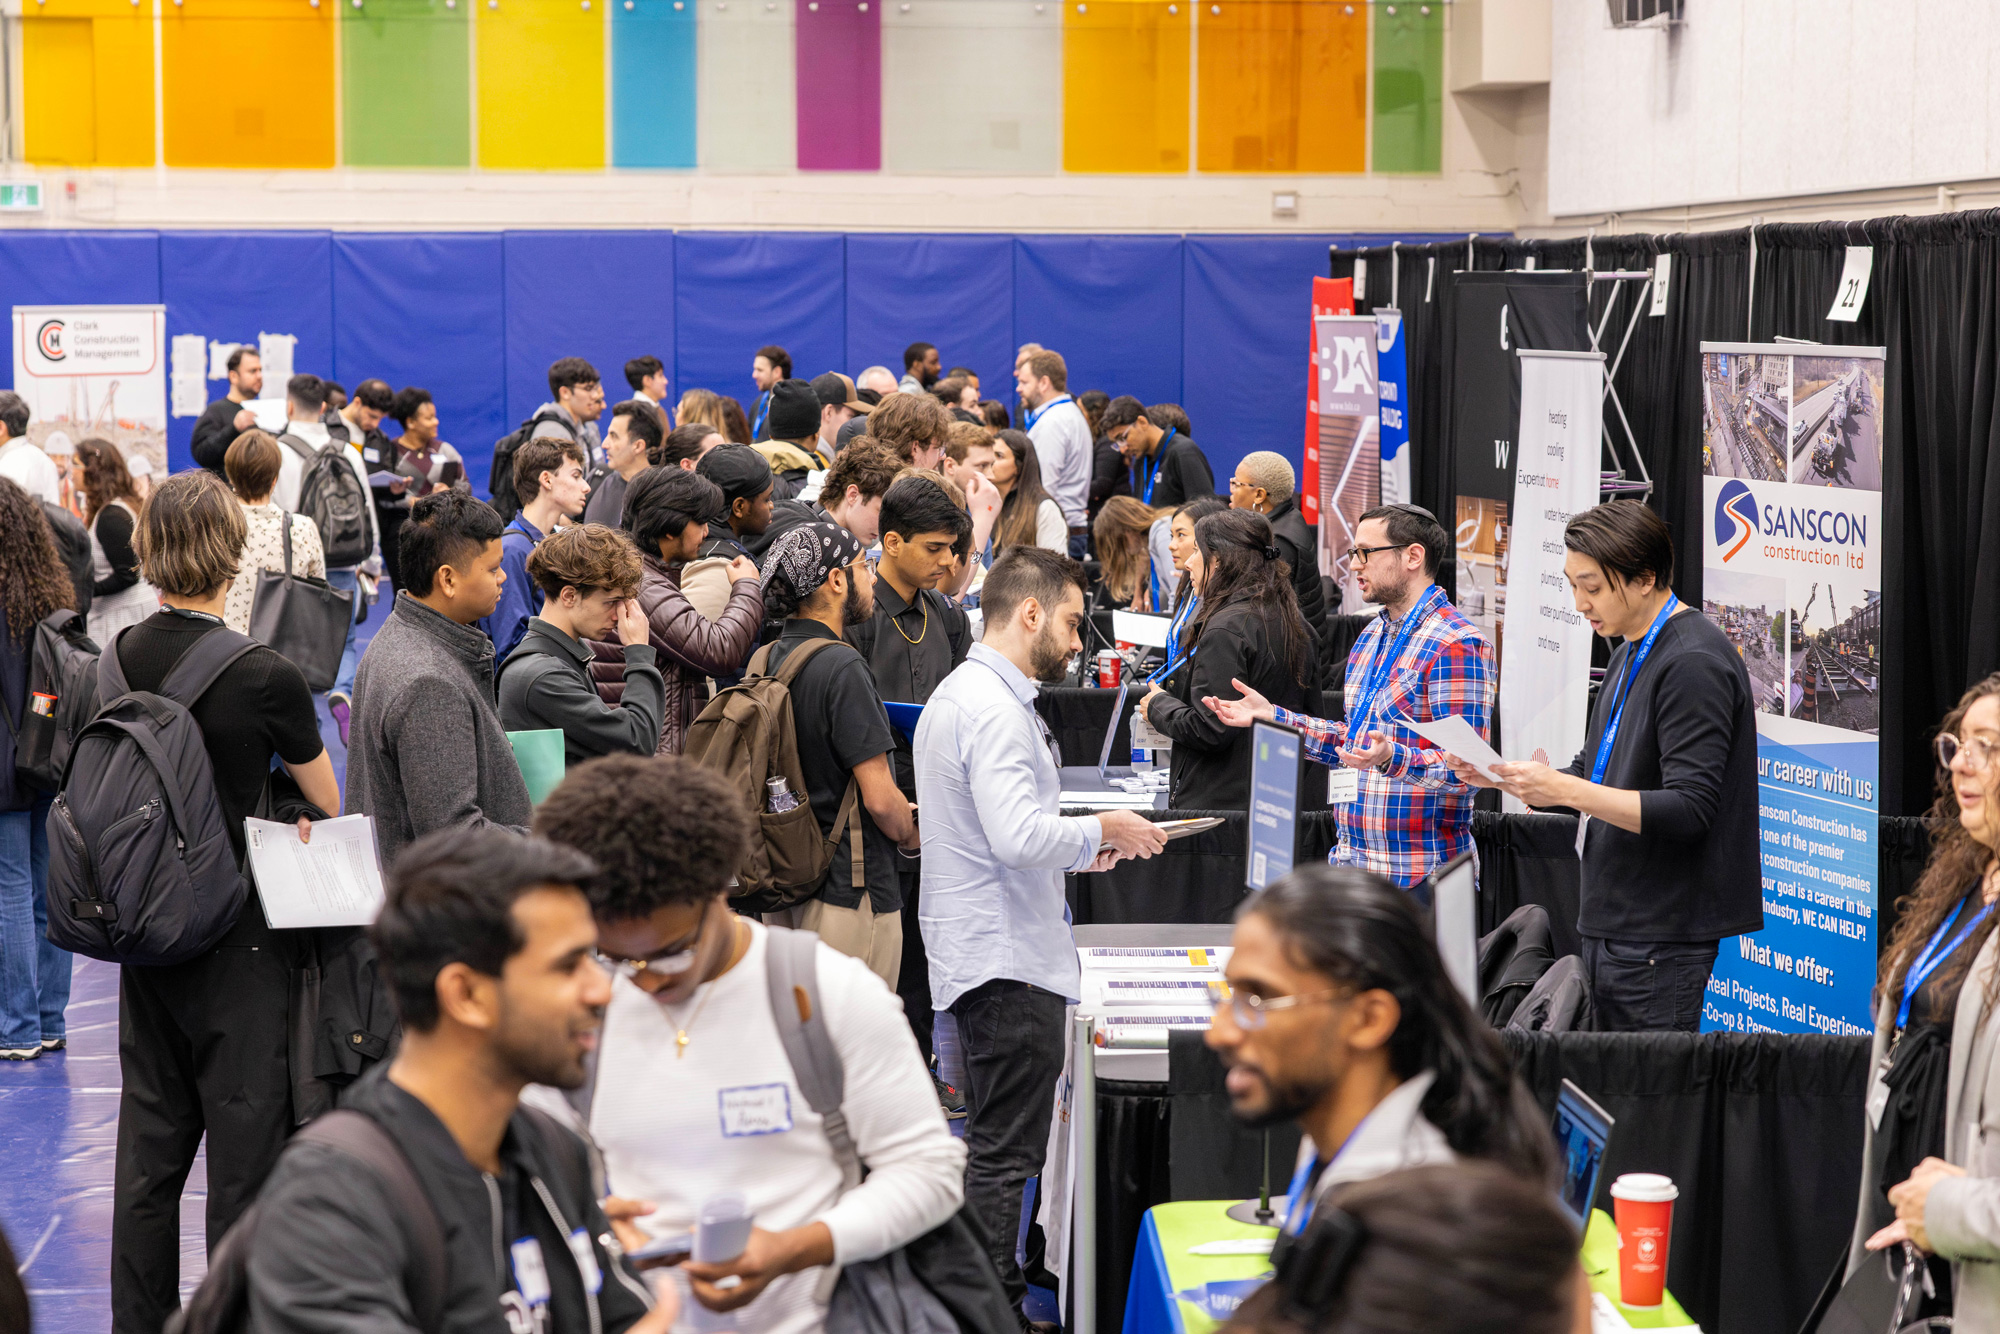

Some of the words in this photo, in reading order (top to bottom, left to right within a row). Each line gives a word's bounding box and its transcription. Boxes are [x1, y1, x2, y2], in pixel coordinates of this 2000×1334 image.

[1841, 279, 1860, 308] 21
[74, 320, 98, 331] Clark
[74, 335, 140, 345] Construction
[74, 349, 140, 360] Management
[1321, 336, 1374, 395] BDA
[1548, 409, 1567, 429] heating
[1546, 442, 1565, 461] cooling
[1763, 504, 1867, 548] SANSCON
[1542, 538, 1564, 555] electrical
[1763, 544, 1840, 567] construction
[1846, 551, 1864, 570] ltd
[1541, 571, 1563, 592] plumbing
[1538, 635, 1548, 649] and
[1548, 641, 1560, 653] more
[1757, 757, 1771, 778] ur
[1773, 760, 1819, 789] career
[1821, 767, 1853, 797] with
[1855, 778, 1873, 802] us
[1758, 804, 1790, 822] anscon
[1791, 809, 1849, 838] Construction
[1851, 823, 1868, 842] has
[1764, 829, 1780, 845] one
[1781, 832, 1791, 847] of
[1793, 834, 1807, 851] the
[1808, 840, 1845, 861] premier
[1764, 852, 1820, 880] construction
[1821, 869, 1871, 893] companies
[1761, 876, 1776, 892] our
[1777, 881, 1796, 897] goal
[1797, 882, 1806, 900] is
[1807, 889, 1813, 902] a
[1814, 891, 1845, 911] career
[1846, 896, 1855, 914] in
[1856, 900, 1872, 918] the
[1762, 896, 1800, 925] Industry,
[1802, 908, 1817, 928] WE
[1818, 913, 1838, 934] CAN
[1839, 918, 1866, 942] HELP!
[1739, 934, 1772, 968] What
[1774, 951, 1793, 974] we
[1796, 956, 1834, 988] offer:
[1732, 980, 1779, 1017] Projects,
[1782, 996, 1806, 1023] Real
[1736, 1012, 1745, 1030] &
